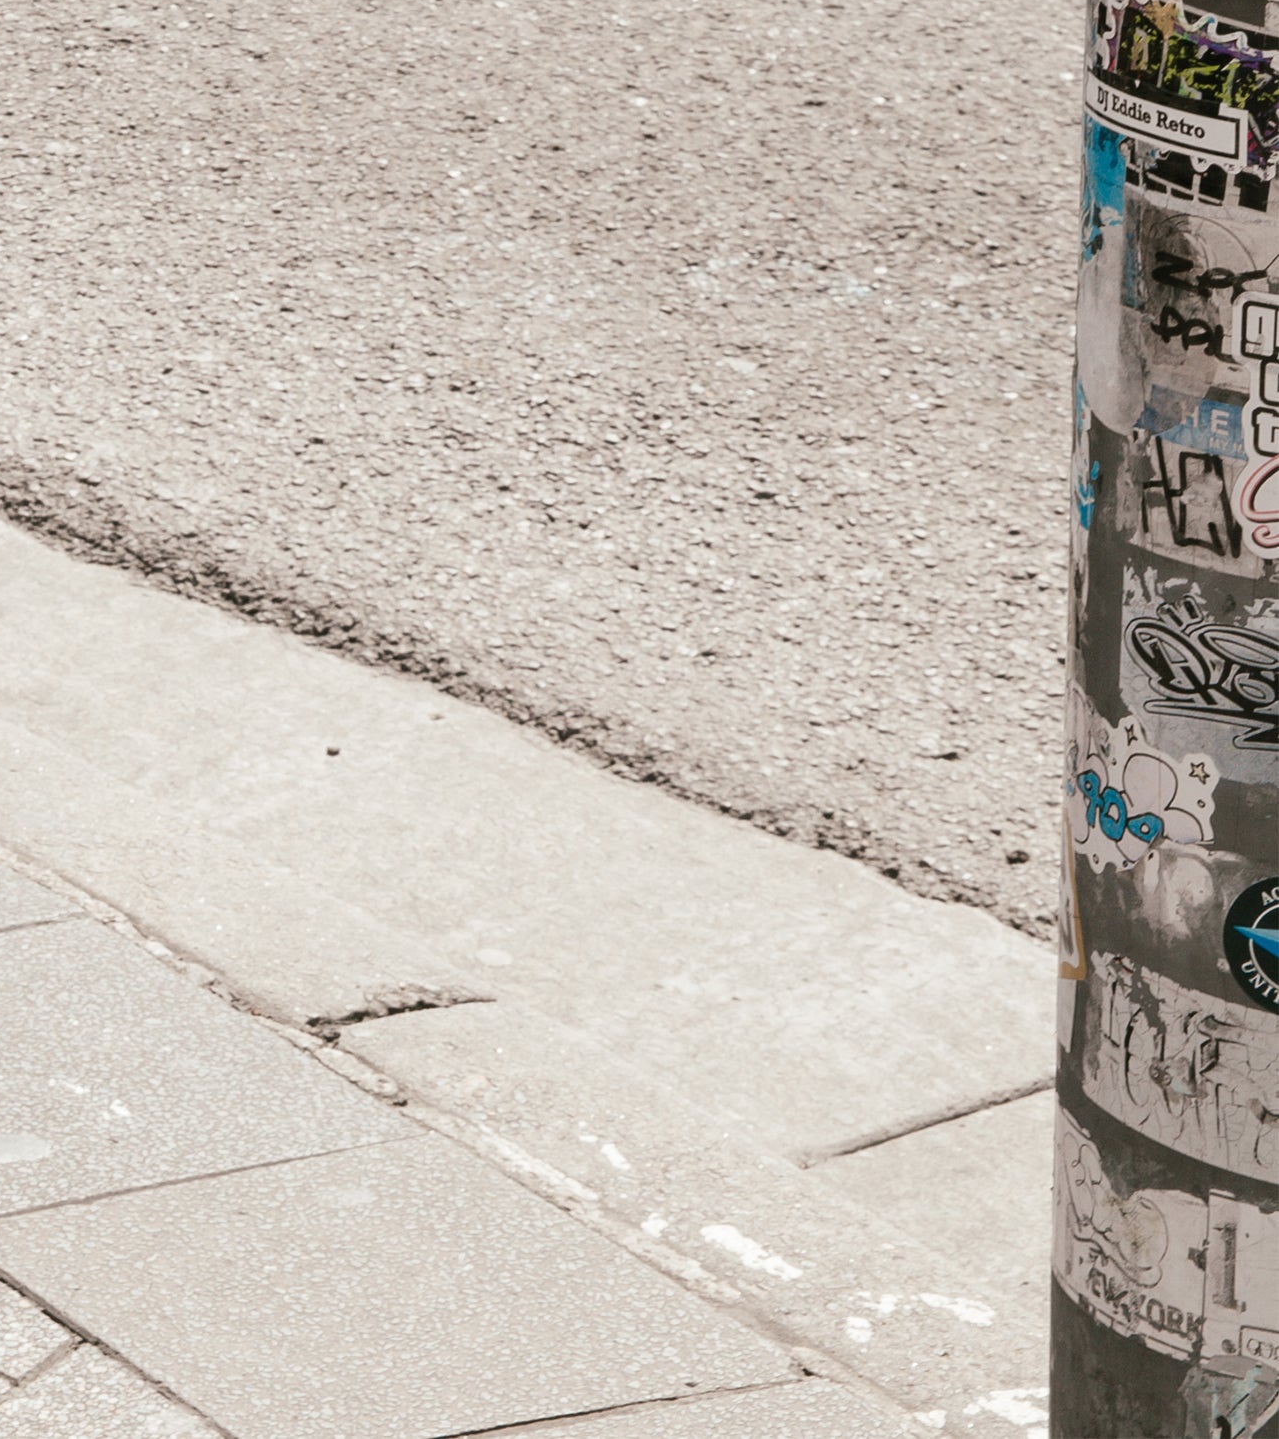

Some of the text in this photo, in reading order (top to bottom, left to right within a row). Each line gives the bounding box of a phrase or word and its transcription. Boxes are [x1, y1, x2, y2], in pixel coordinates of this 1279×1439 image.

[1097, 85, 1205, 140] DJ Eddie Retro
